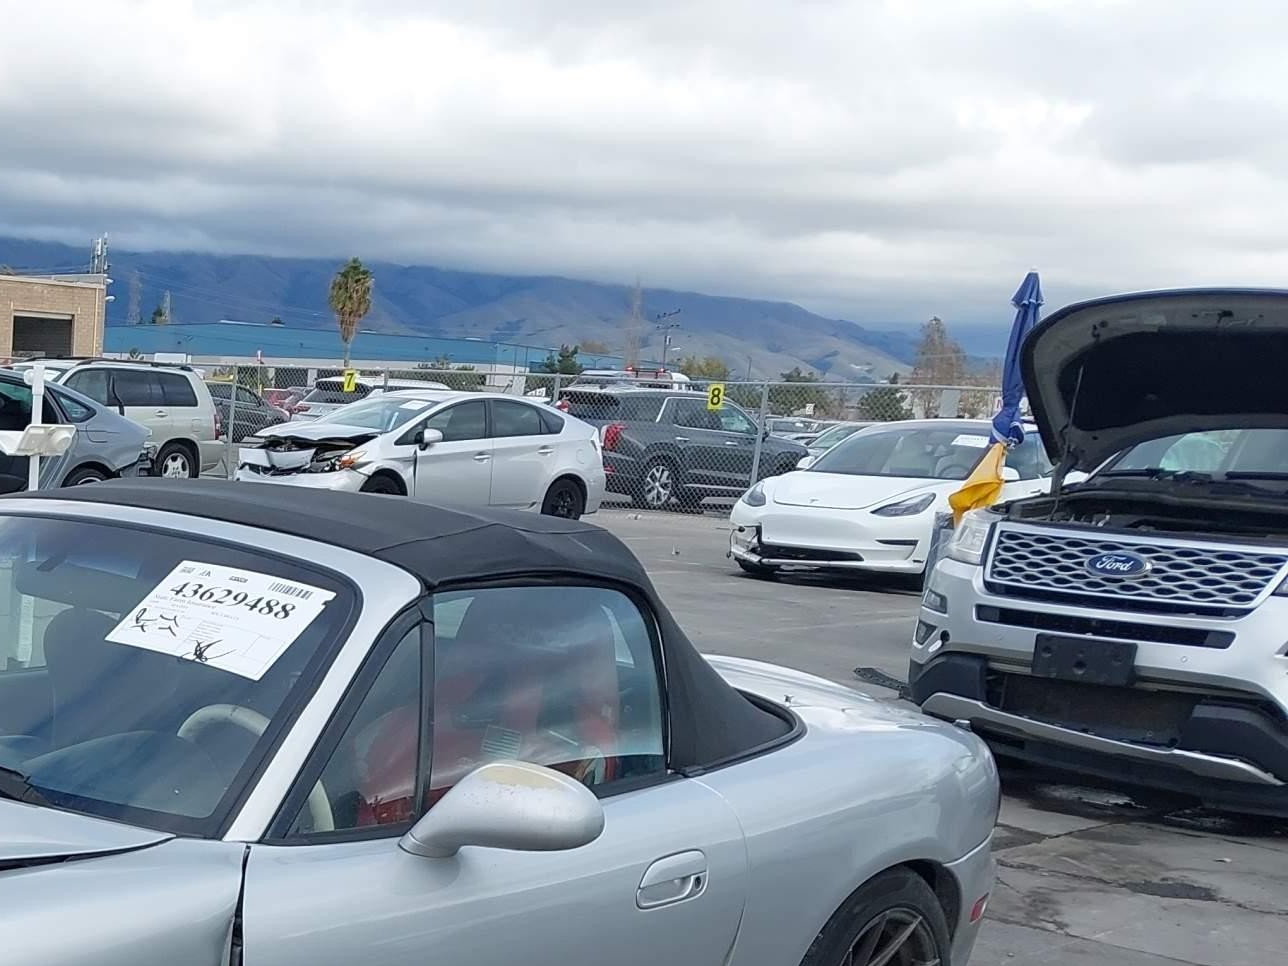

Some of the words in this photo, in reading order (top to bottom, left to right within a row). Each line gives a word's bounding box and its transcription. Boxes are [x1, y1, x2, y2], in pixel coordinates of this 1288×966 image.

[346, 372, 355, 389] 7
[710, 387, 722, 406] 8
[1095, 555, 1135, 571] Ford
[169, 581, 297, 621] 43629488
